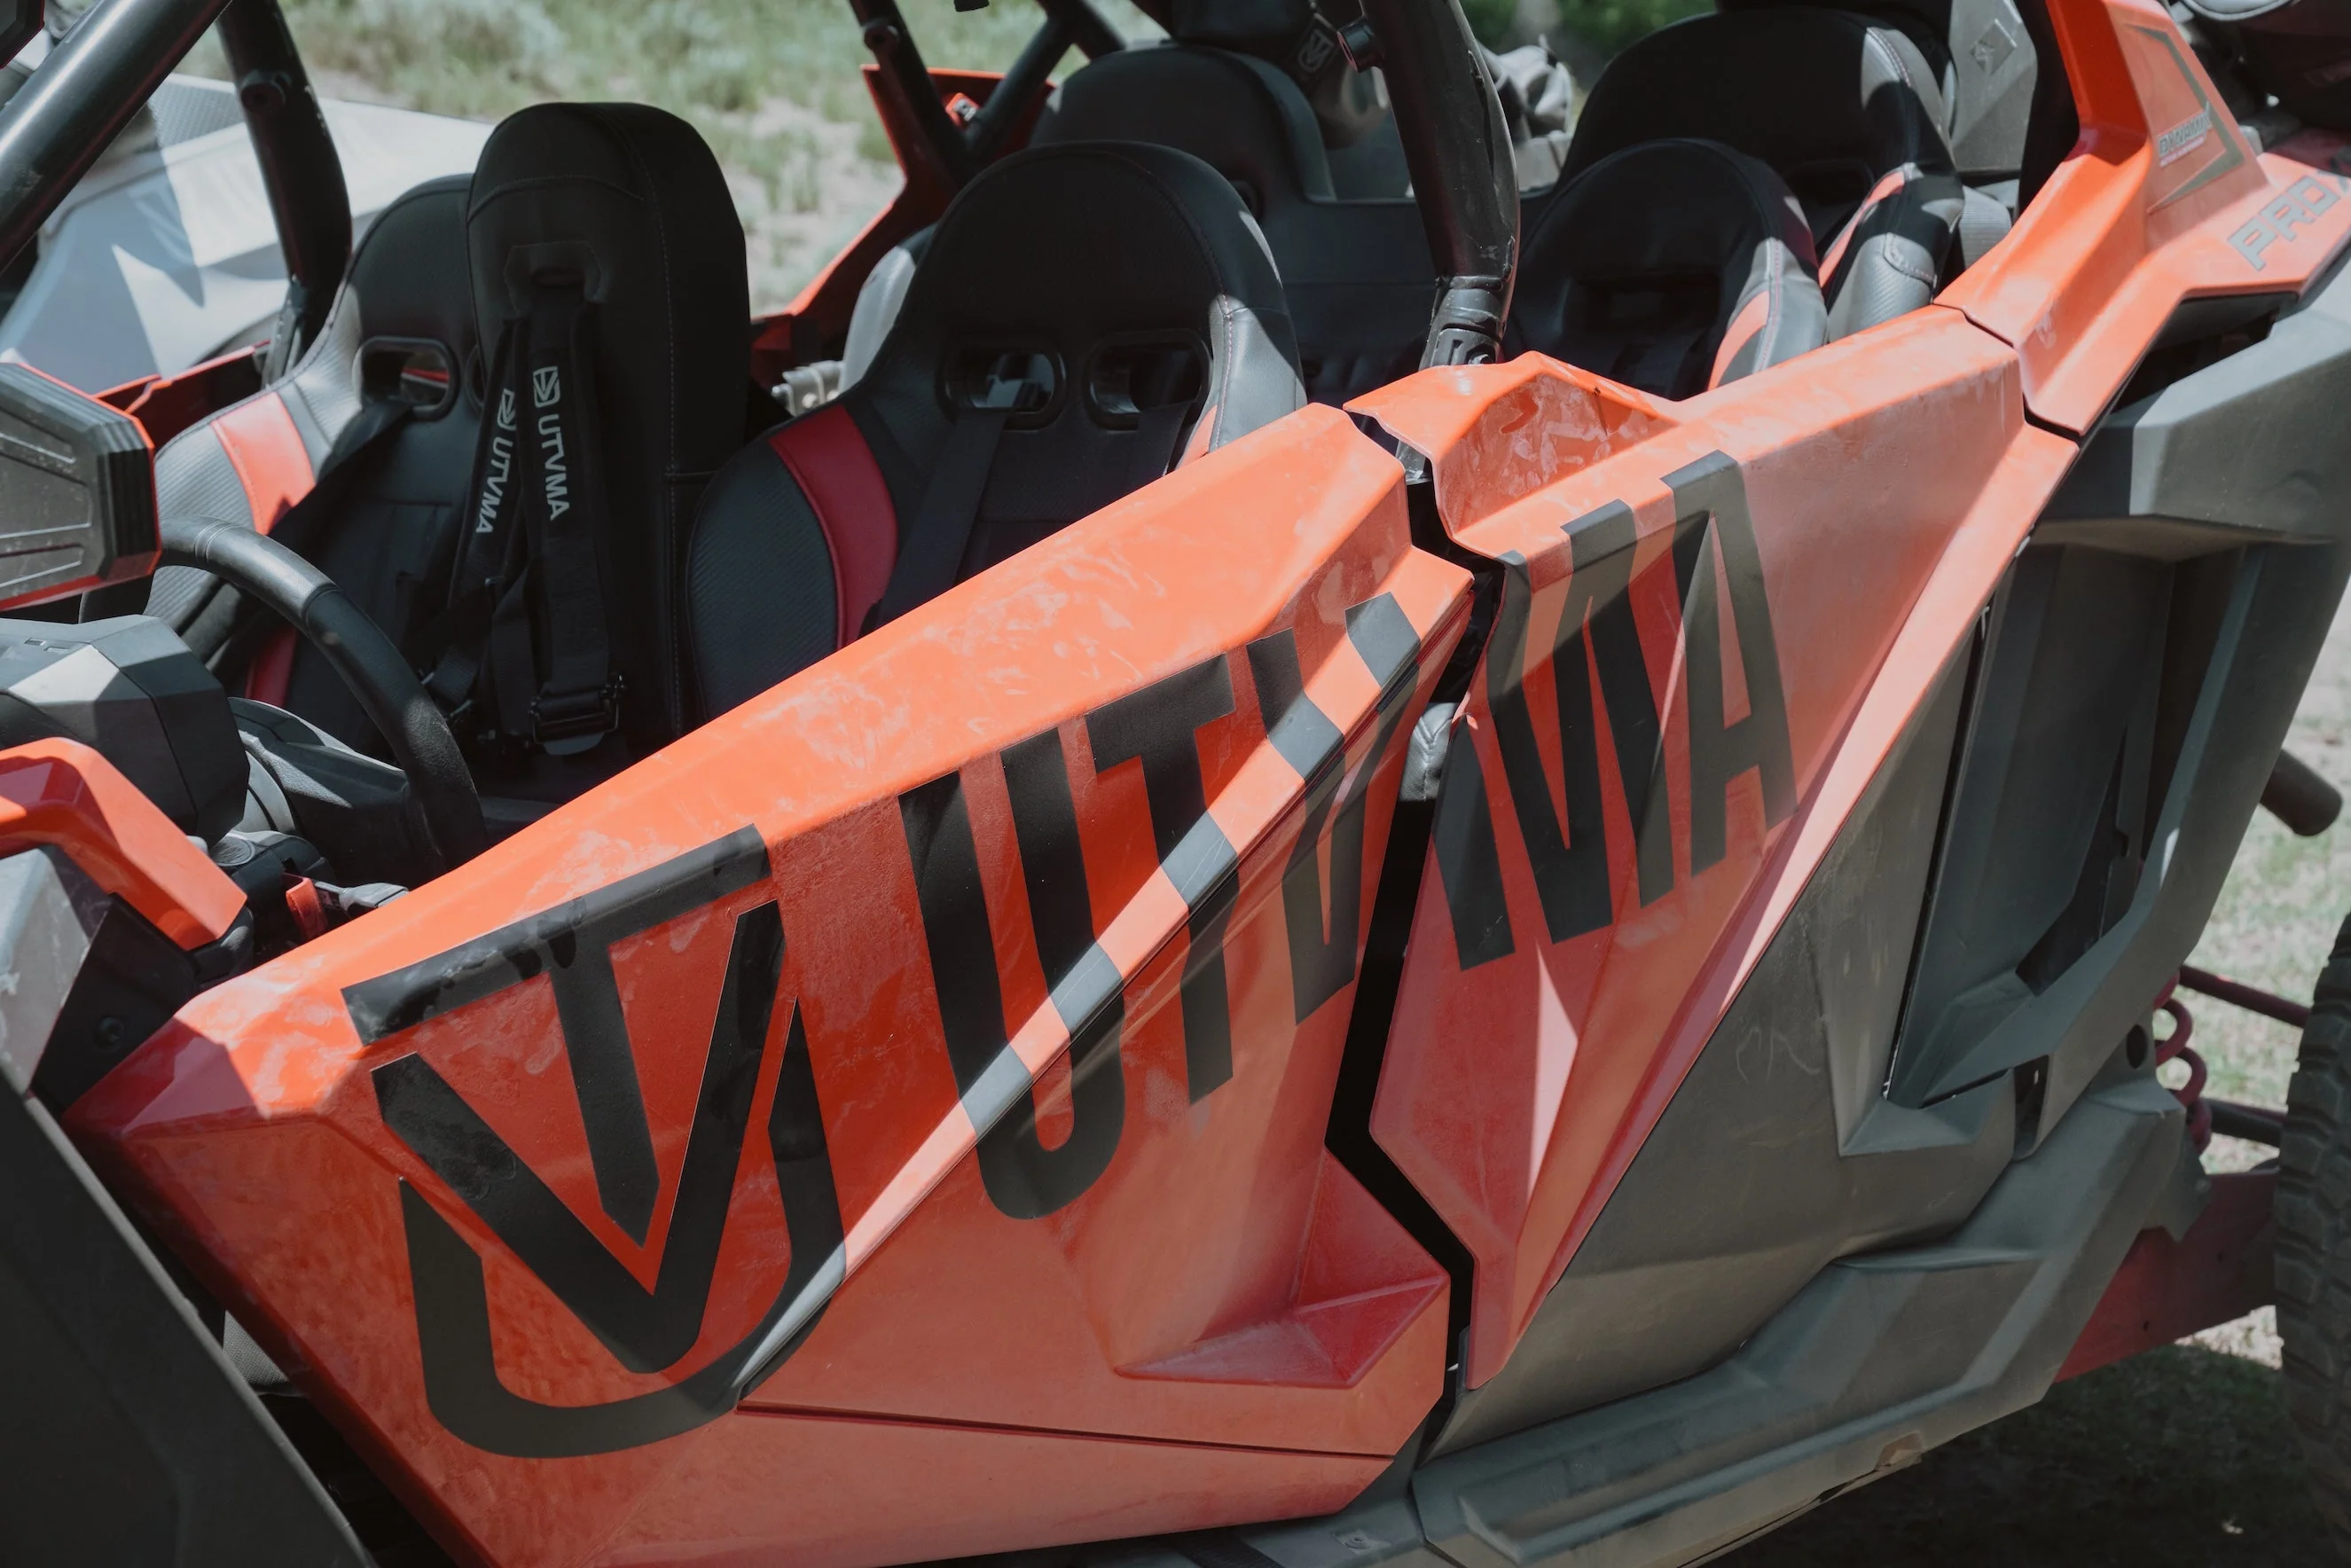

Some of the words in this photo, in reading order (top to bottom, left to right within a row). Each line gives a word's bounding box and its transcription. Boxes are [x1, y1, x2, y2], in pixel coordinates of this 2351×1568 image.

[2227, 175, 2341, 272] PRO
[475, 436, 514, 533] UTVMA
[538, 413, 570, 521] UTVMA
[897, 450, 1799, 1220] UTVMA
